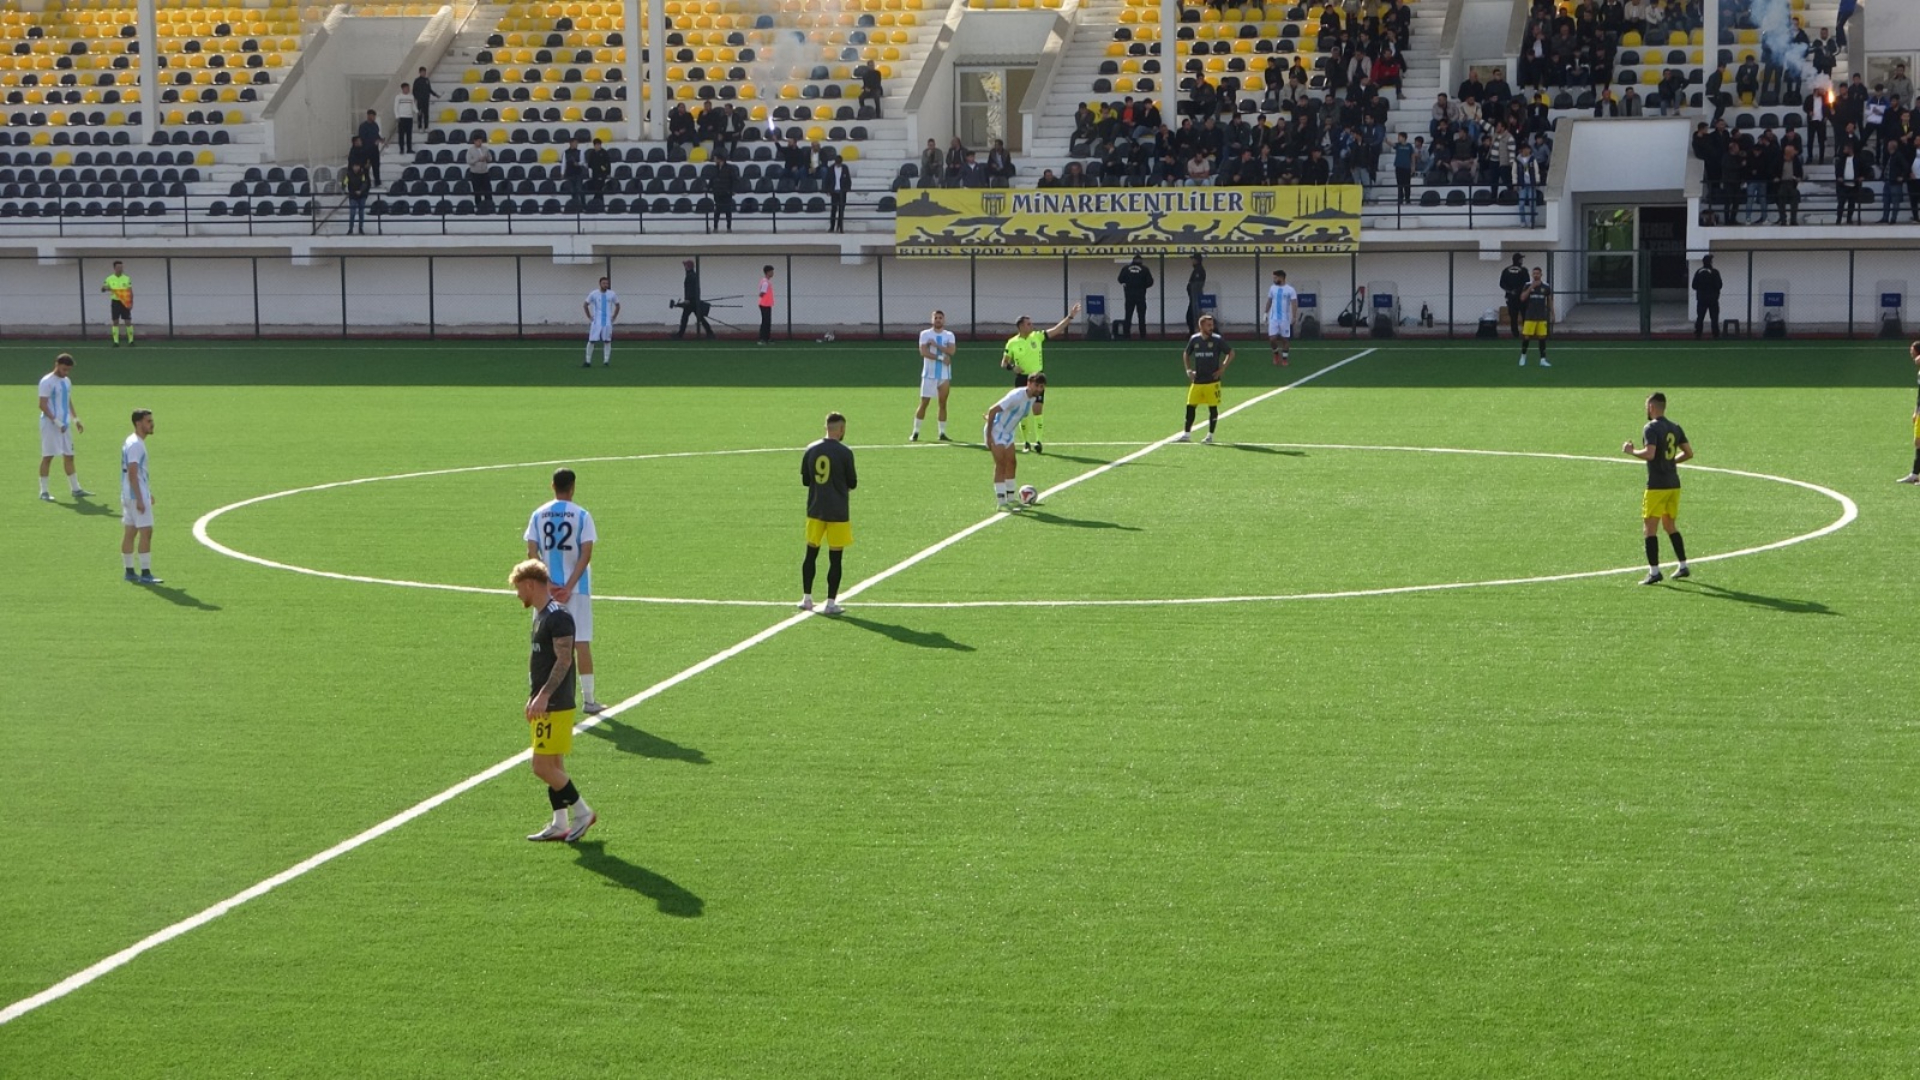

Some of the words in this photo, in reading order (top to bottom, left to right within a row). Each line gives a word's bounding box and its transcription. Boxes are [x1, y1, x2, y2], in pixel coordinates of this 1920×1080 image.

[1665, 432, 1676, 461] 3
[815, 454, 830, 485] 9
[543, 521, 572, 551] 82
[536, 722, 552, 739] 61
